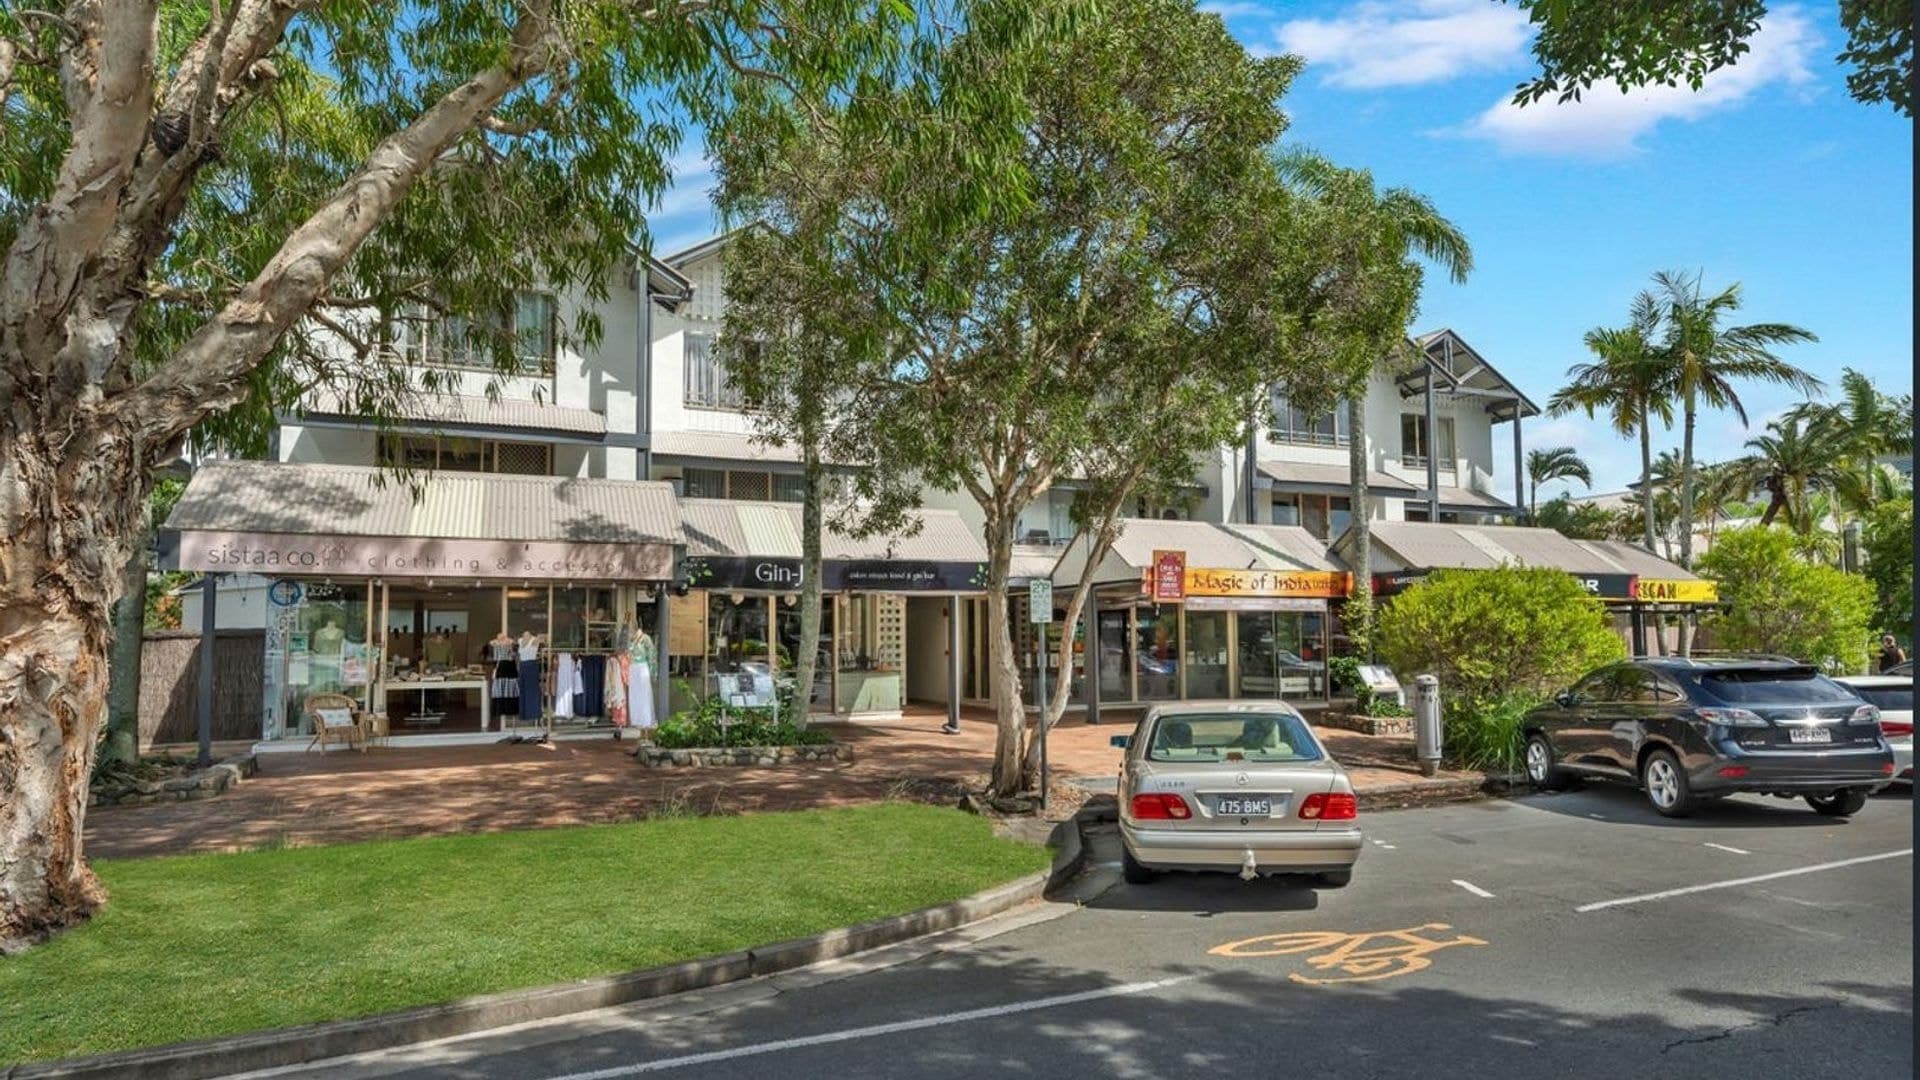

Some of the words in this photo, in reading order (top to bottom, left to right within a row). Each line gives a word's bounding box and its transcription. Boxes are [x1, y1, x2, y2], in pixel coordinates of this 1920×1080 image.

[208, 544, 280, 565] sistaa
[286, 551, 320, 566] co.
[367, 555, 480, 573] clothing
[496, 557, 508, 570] &
[1193, 573, 1243, 592] Magic
[1250, 574, 1269, 590] of
[1274, 575, 1312, 590] India
[1219, 800, 1241, 813] 475
[1243, 800, 1270, 813] BMS
